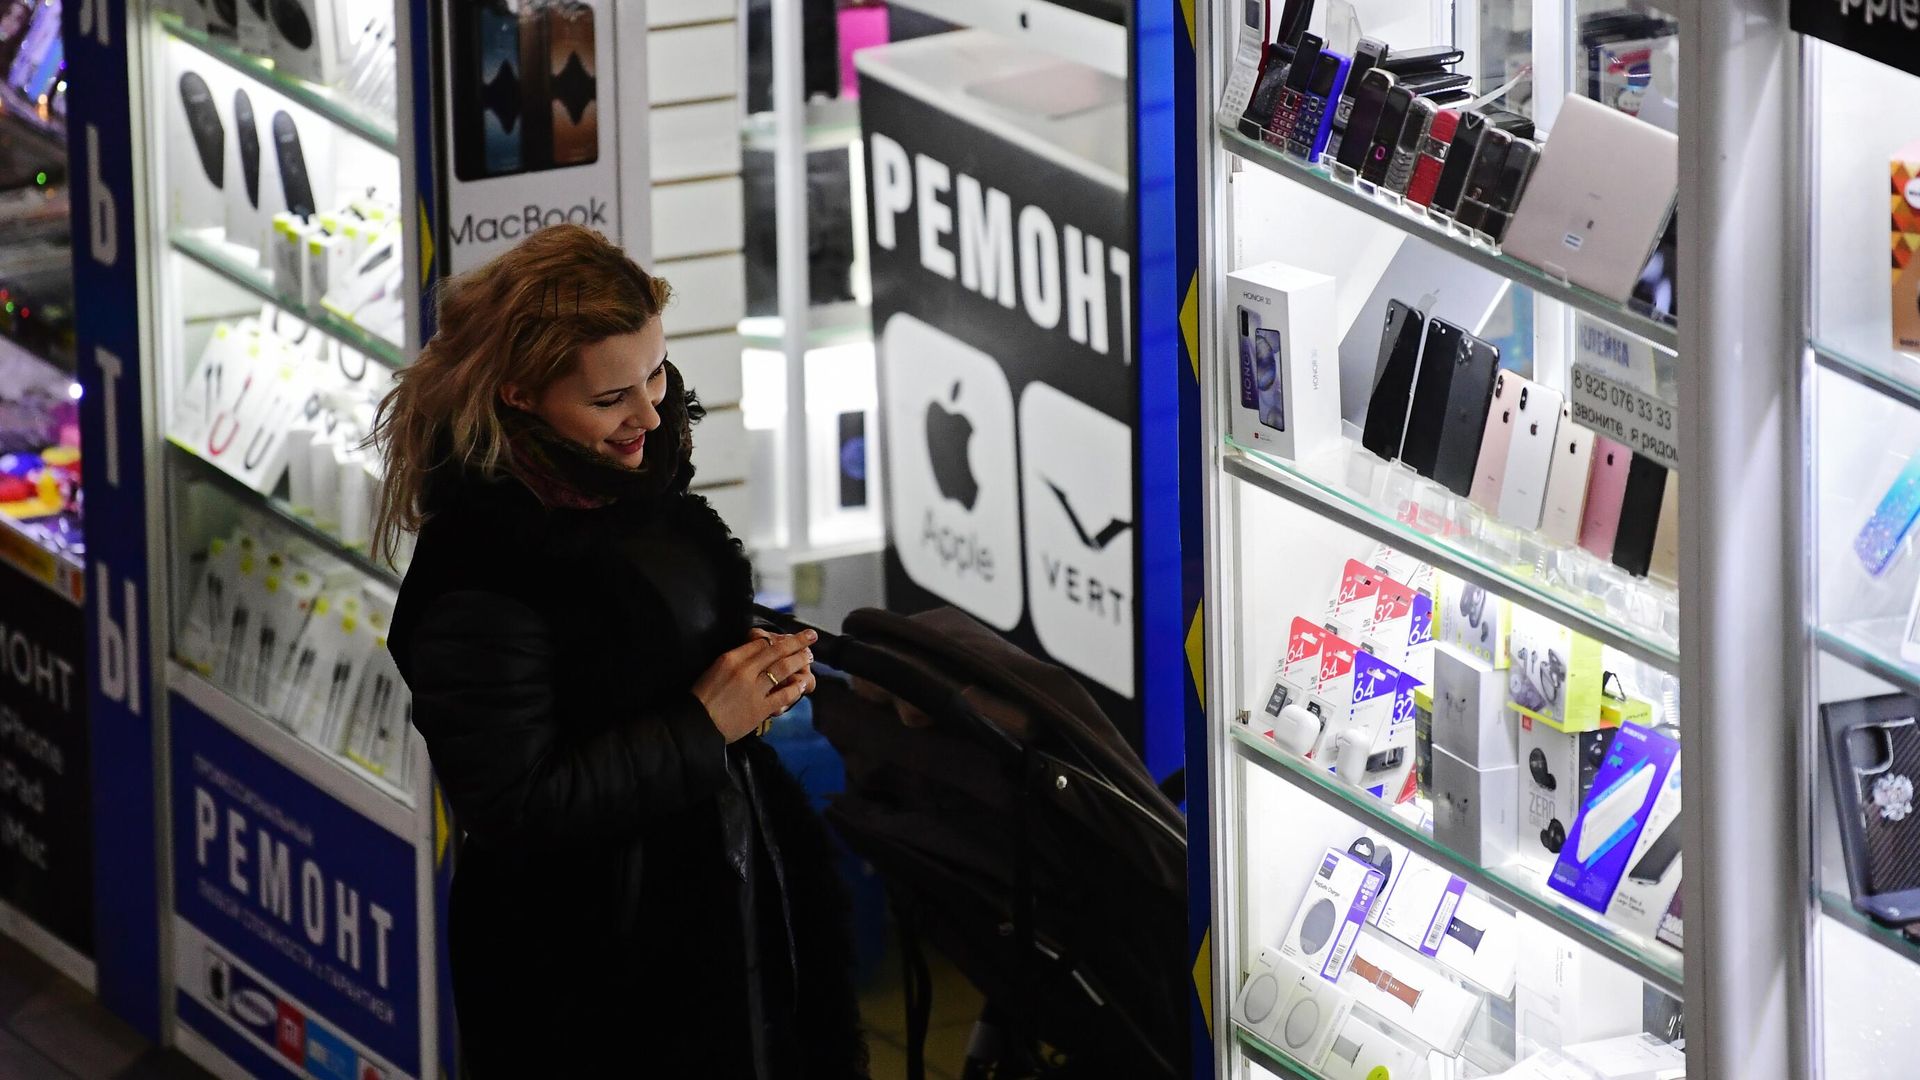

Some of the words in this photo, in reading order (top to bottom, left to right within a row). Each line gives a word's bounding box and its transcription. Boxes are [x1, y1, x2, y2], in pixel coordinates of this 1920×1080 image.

[450, 197, 607, 246] MacBook
[1243, 291, 1265, 303] HONOR
[1575, 369, 1583, 389] 8
[1585, 374, 1608, 401] 925
[1611, 386, 1634, 414] 076
[1638, 398, 1653, 422] 33
[1657, 407, 1672, 431] 33
[1631, 428, 1639, 442] я
[920, 509, 995, 583] Apple
[1040, 552, 1124, 625] VERT
[1339, 583, 1357, 604] 64
[1374, 601, 1395, 623] 32
[1409, 620, 1433, 645] 64
[1287, 641, 1304, 663] 64
[1320, 657, 1338, 680] 64
[1353, 677, 1375, 703] 64
[1392, 698, 1415, 724] 32
[194, 786, 393, 990] РЕМОНТ
